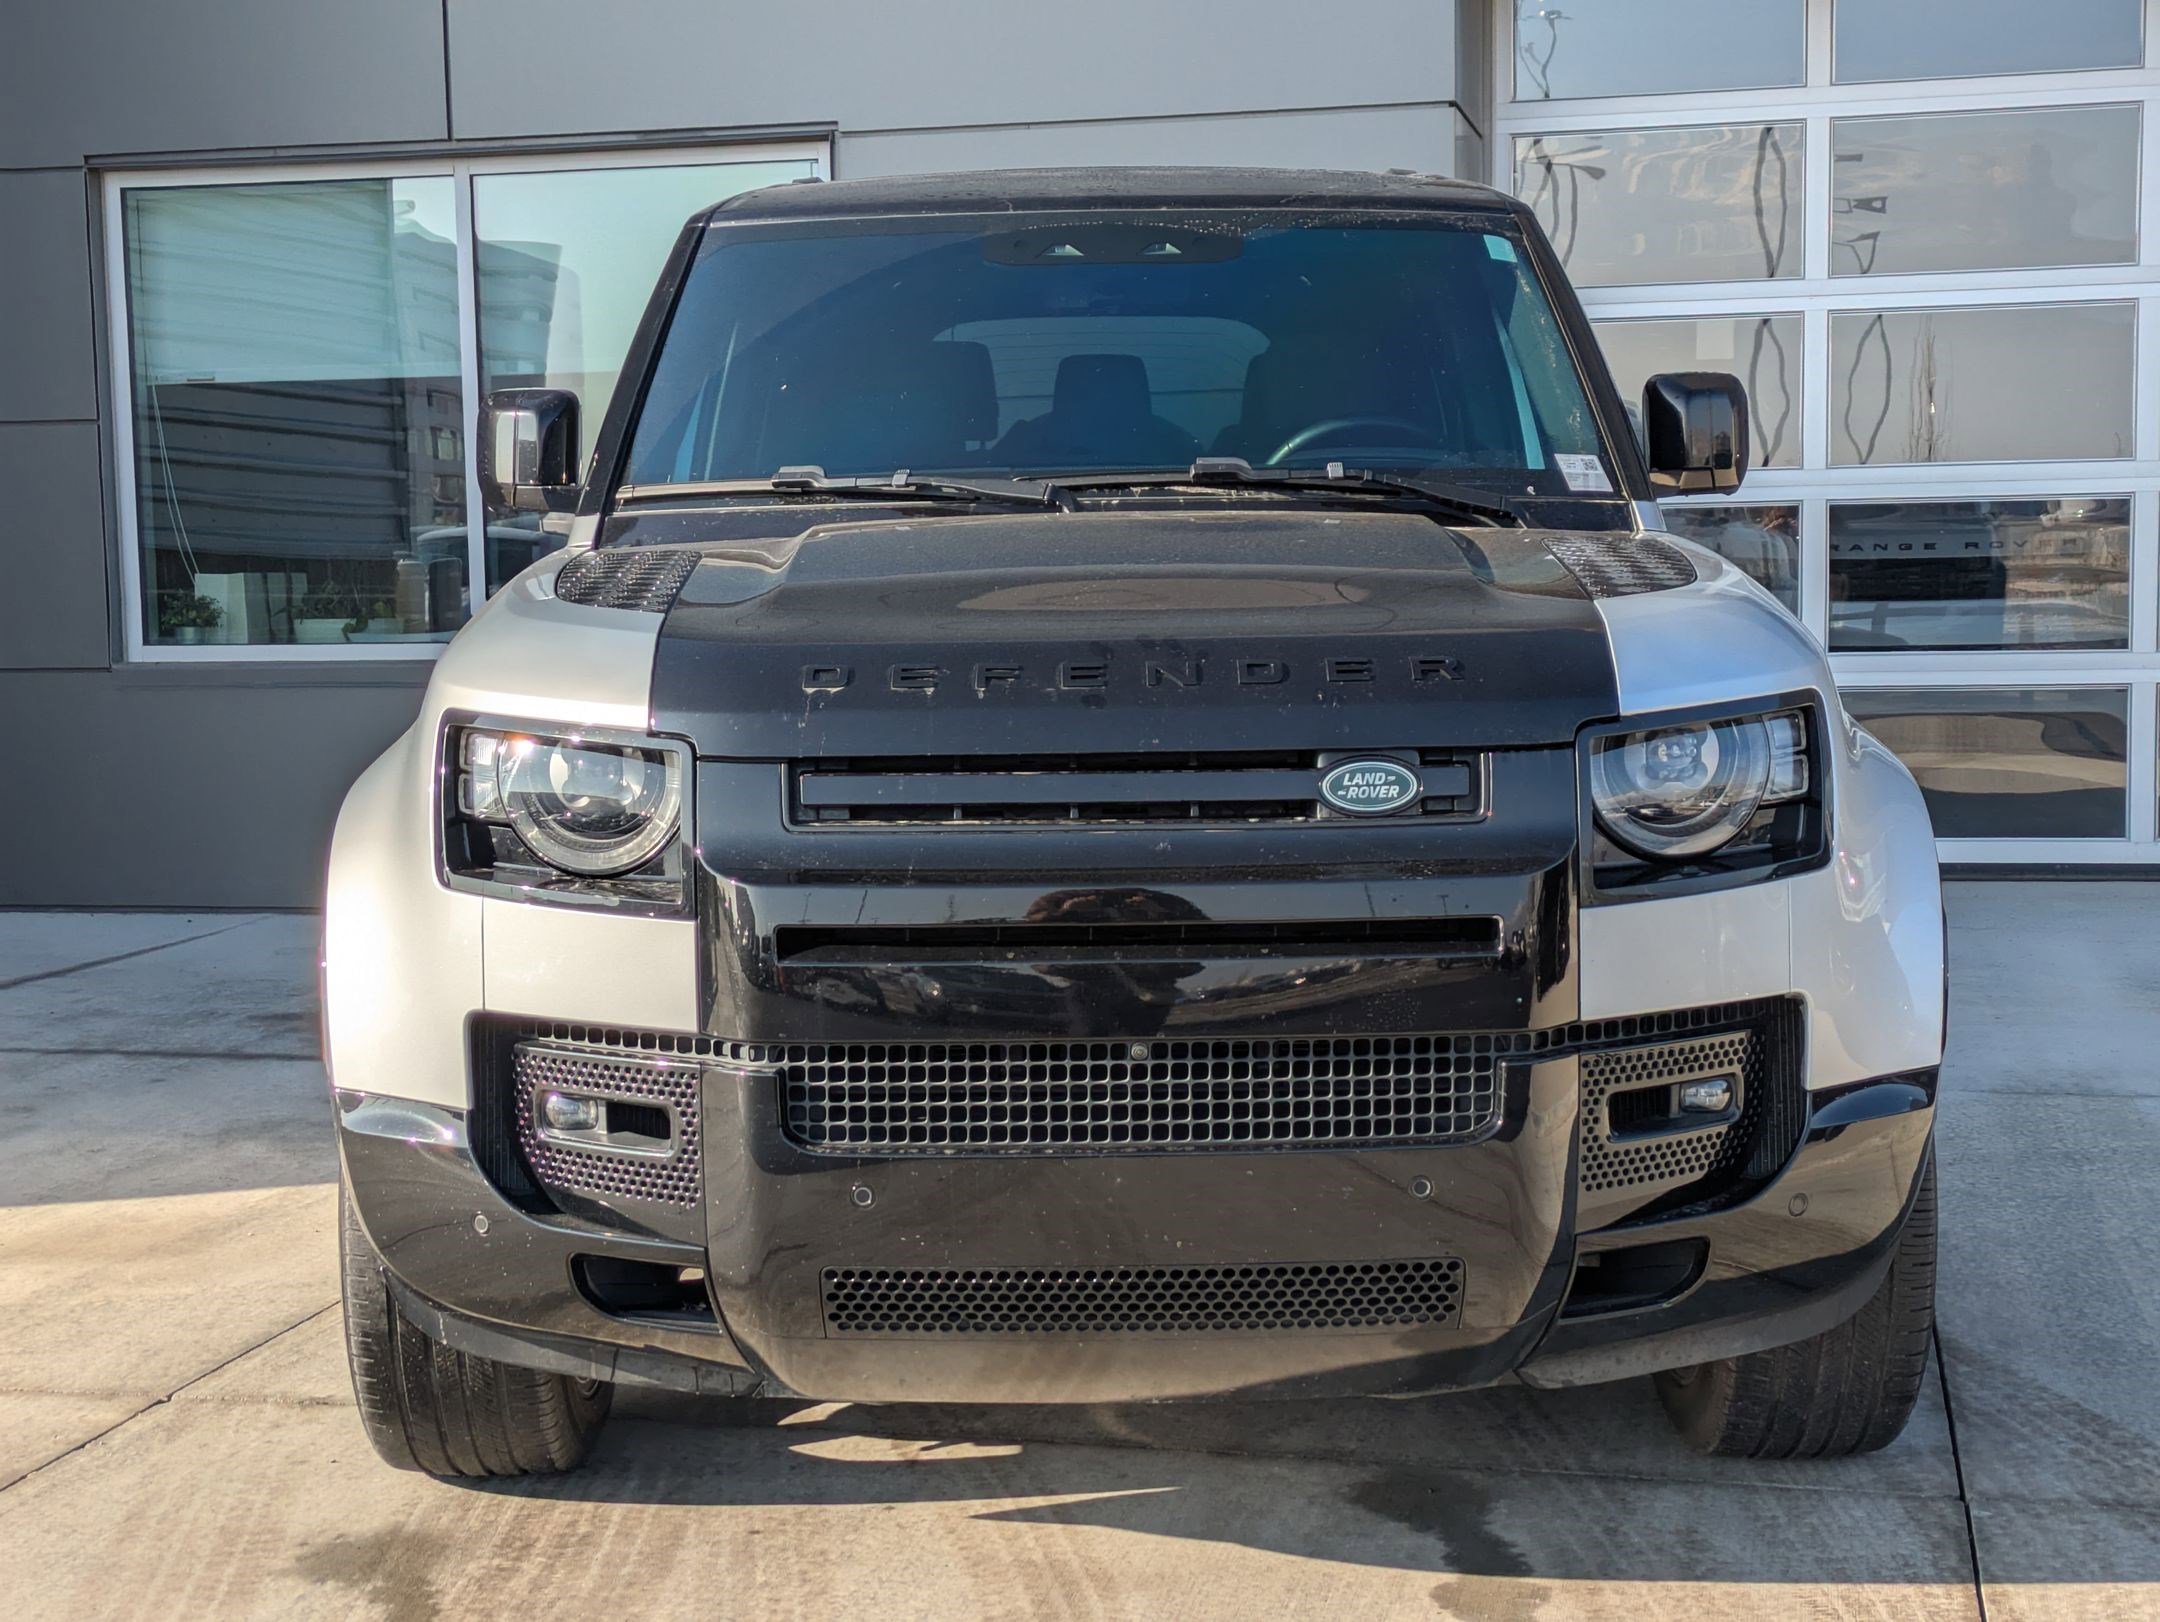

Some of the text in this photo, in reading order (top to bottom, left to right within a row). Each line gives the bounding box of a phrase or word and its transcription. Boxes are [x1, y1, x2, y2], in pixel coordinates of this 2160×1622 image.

[801, 656, 1466, 690] DEFENDER
[1343, 772, 1386, 786] LAND
[1346, 785, 1400, 799] ROVER
